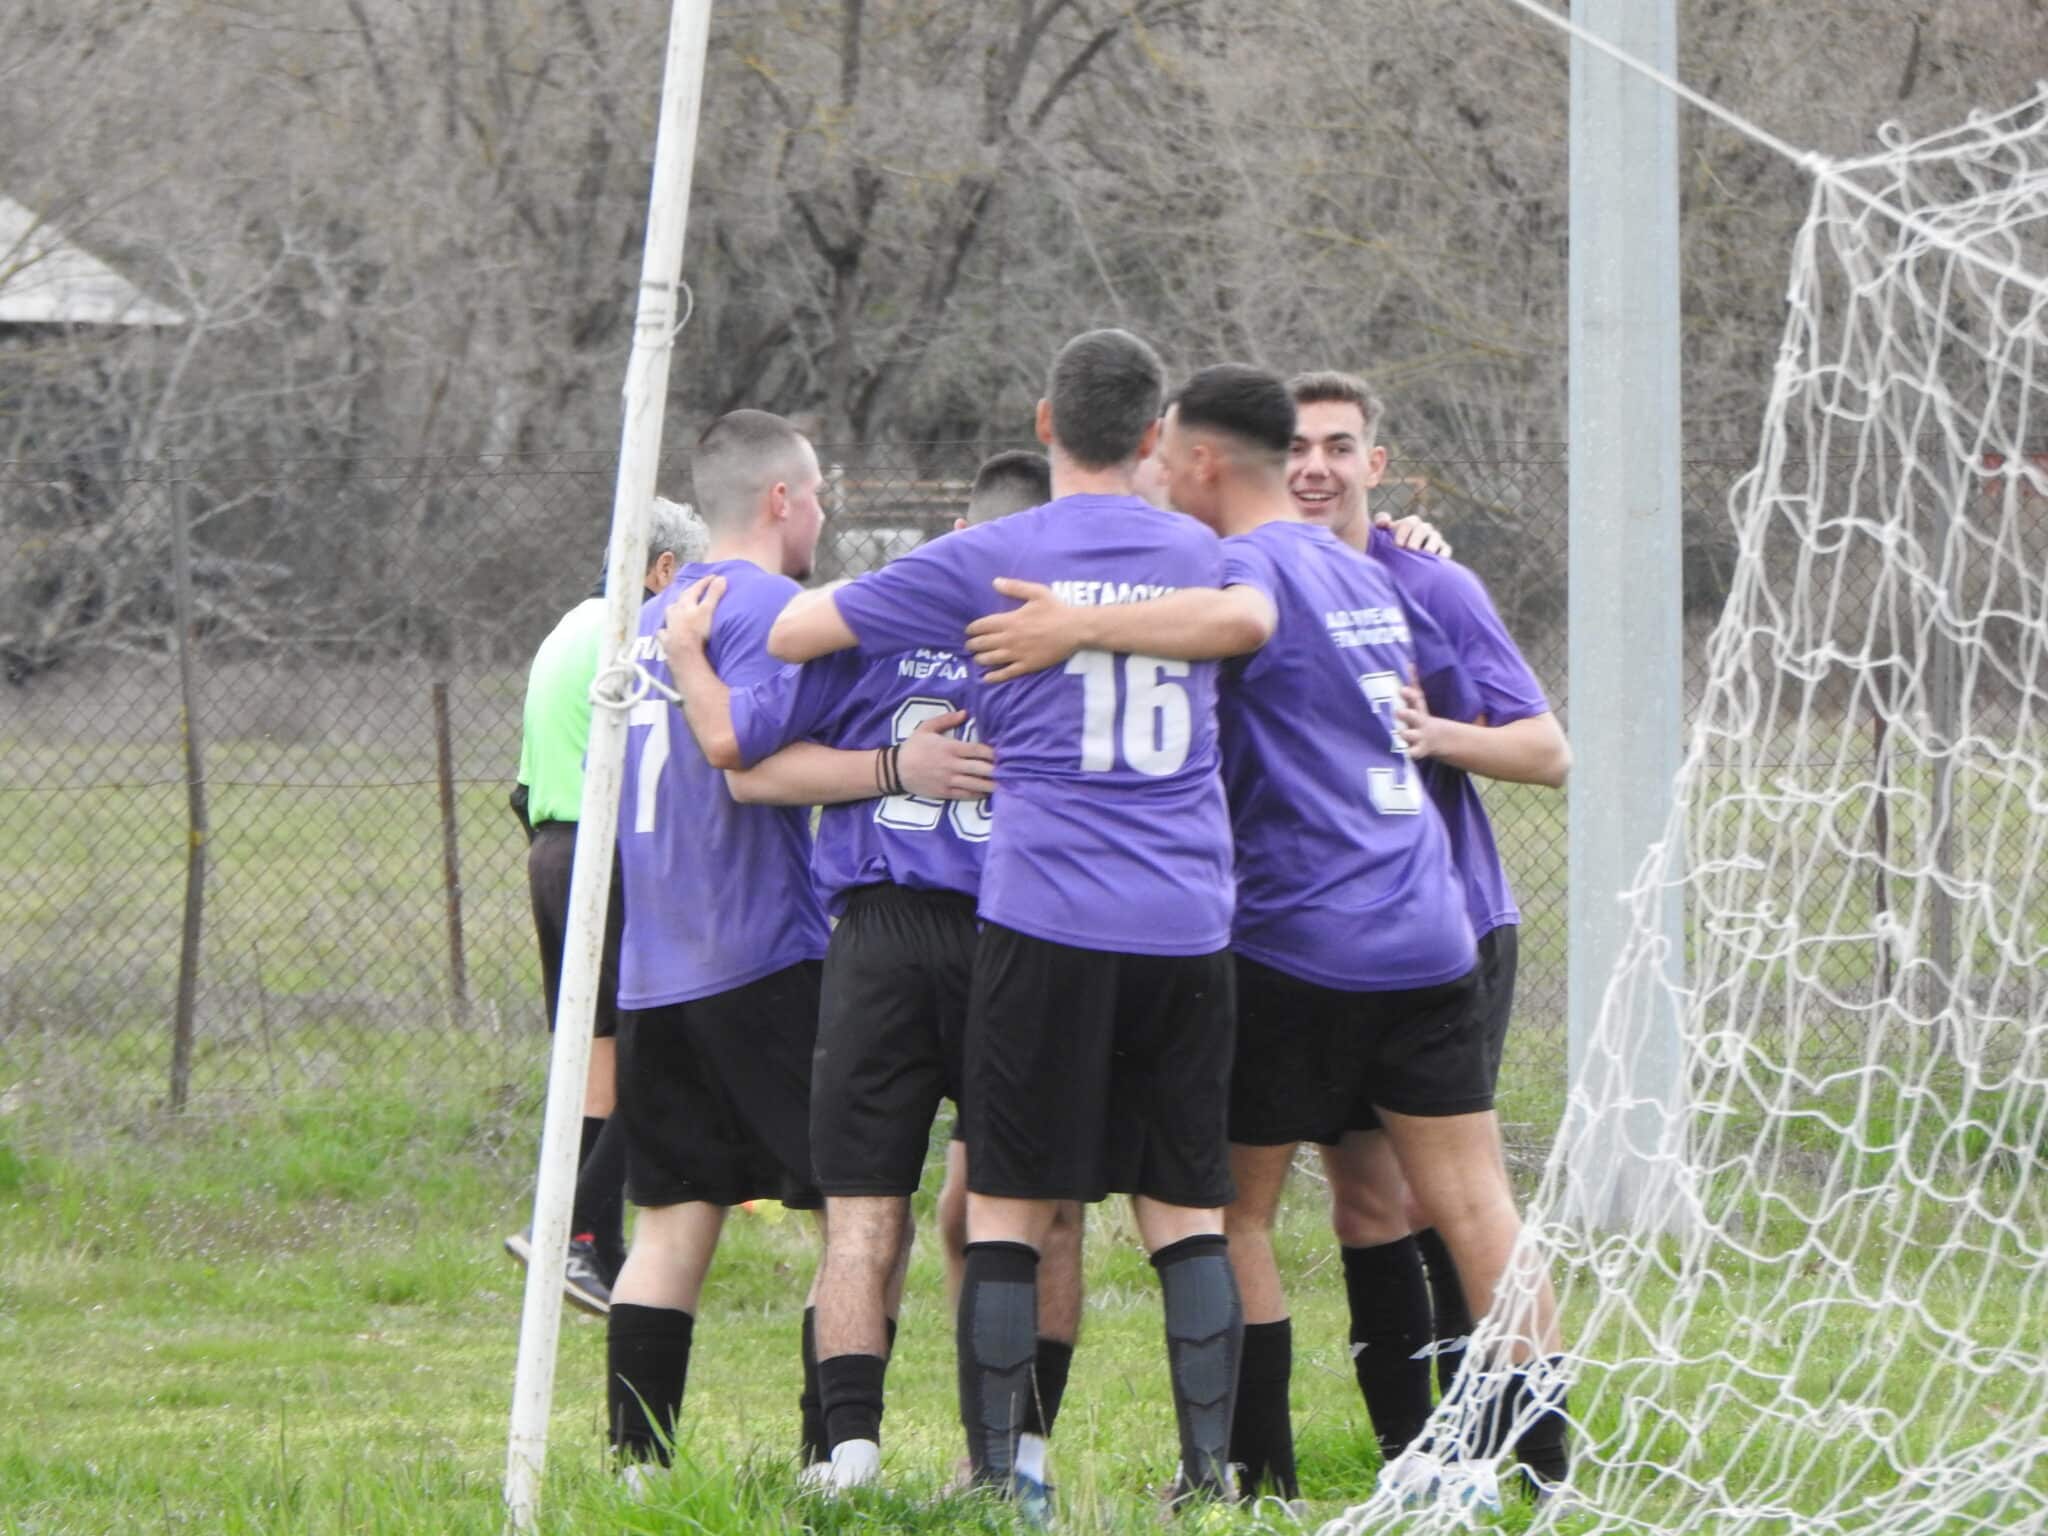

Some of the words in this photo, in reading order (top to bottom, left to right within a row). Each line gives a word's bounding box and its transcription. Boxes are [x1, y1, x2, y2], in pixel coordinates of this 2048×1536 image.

[627, 699, 671, 833] 7
[1063, 650, 1192, 776] 16
[1358, 671, 1425, 815] 3
